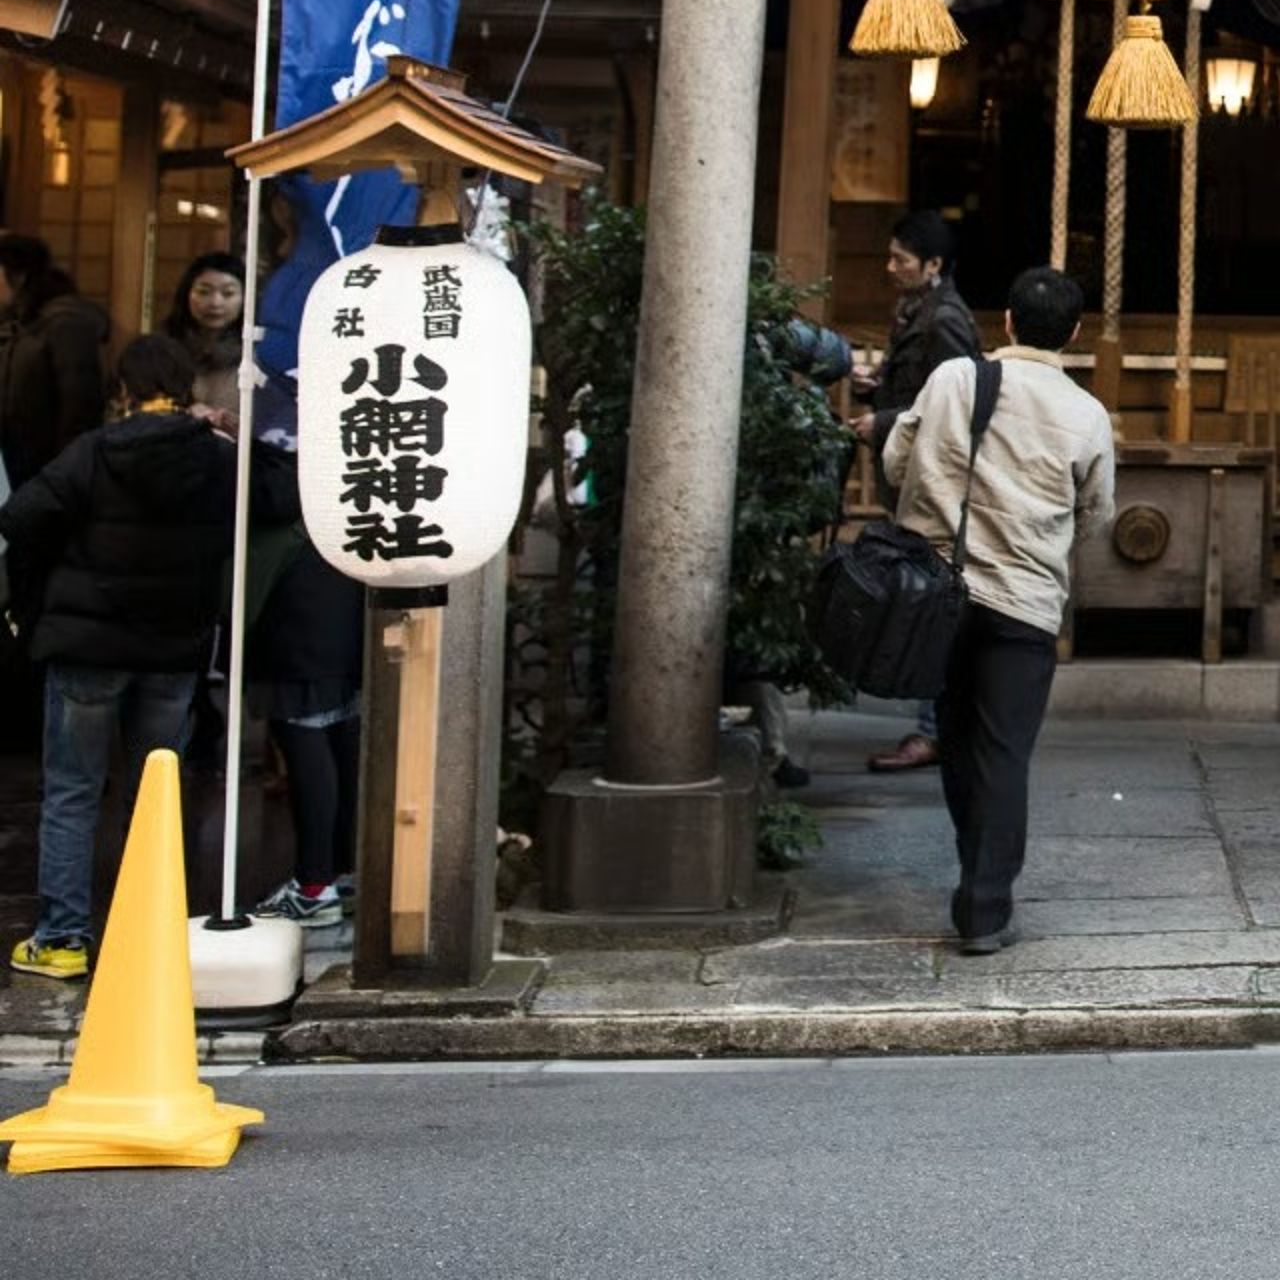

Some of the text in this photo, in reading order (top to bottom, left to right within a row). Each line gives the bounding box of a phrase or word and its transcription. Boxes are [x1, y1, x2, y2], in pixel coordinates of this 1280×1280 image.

[331, 262, 382, 338] 古社
[422, 263, 464, 340] 武蔵国
[337, 342, 455, 563] 小網神社
